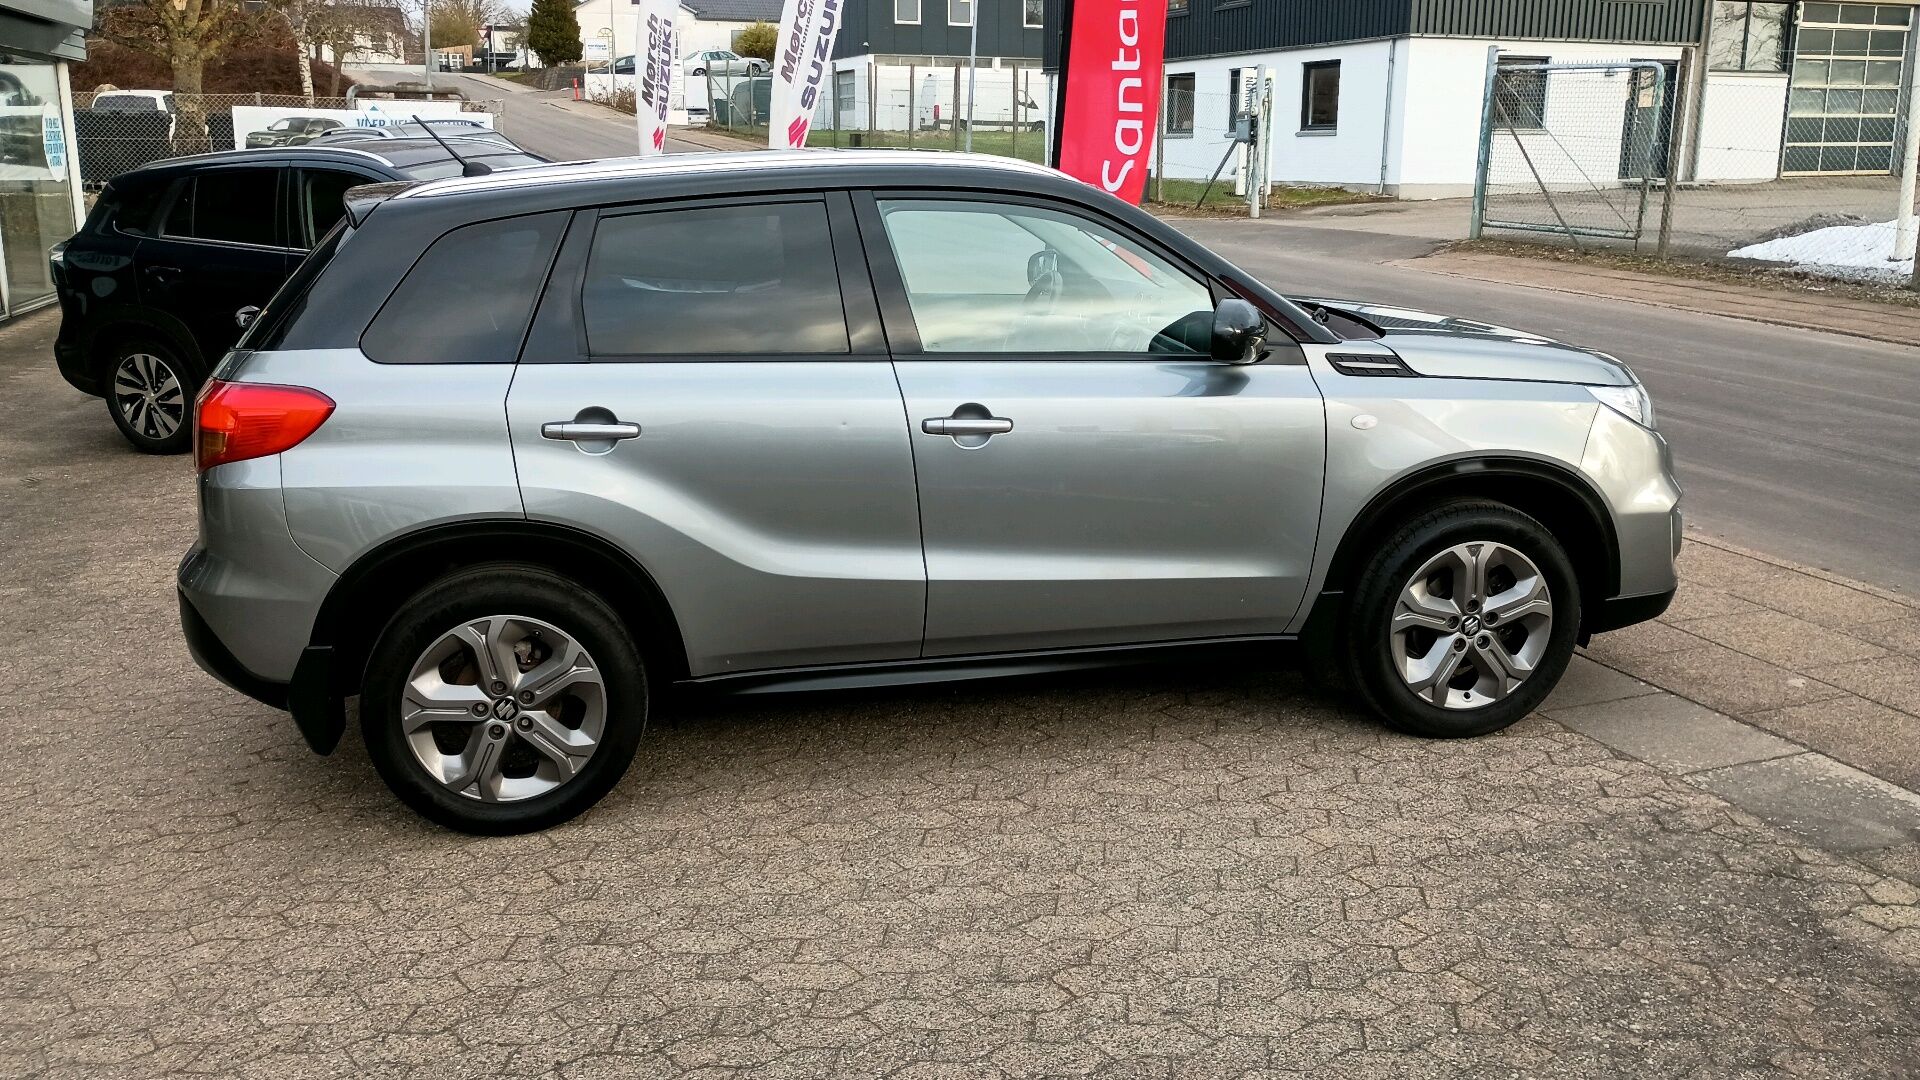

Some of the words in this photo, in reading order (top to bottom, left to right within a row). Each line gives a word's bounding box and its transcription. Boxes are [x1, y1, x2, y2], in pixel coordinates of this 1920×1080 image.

[641, 13, 658, 108] Mørch
[658, 18, 672, 122] SUZUKI
[1101, 0, 1144, 193] Santa
